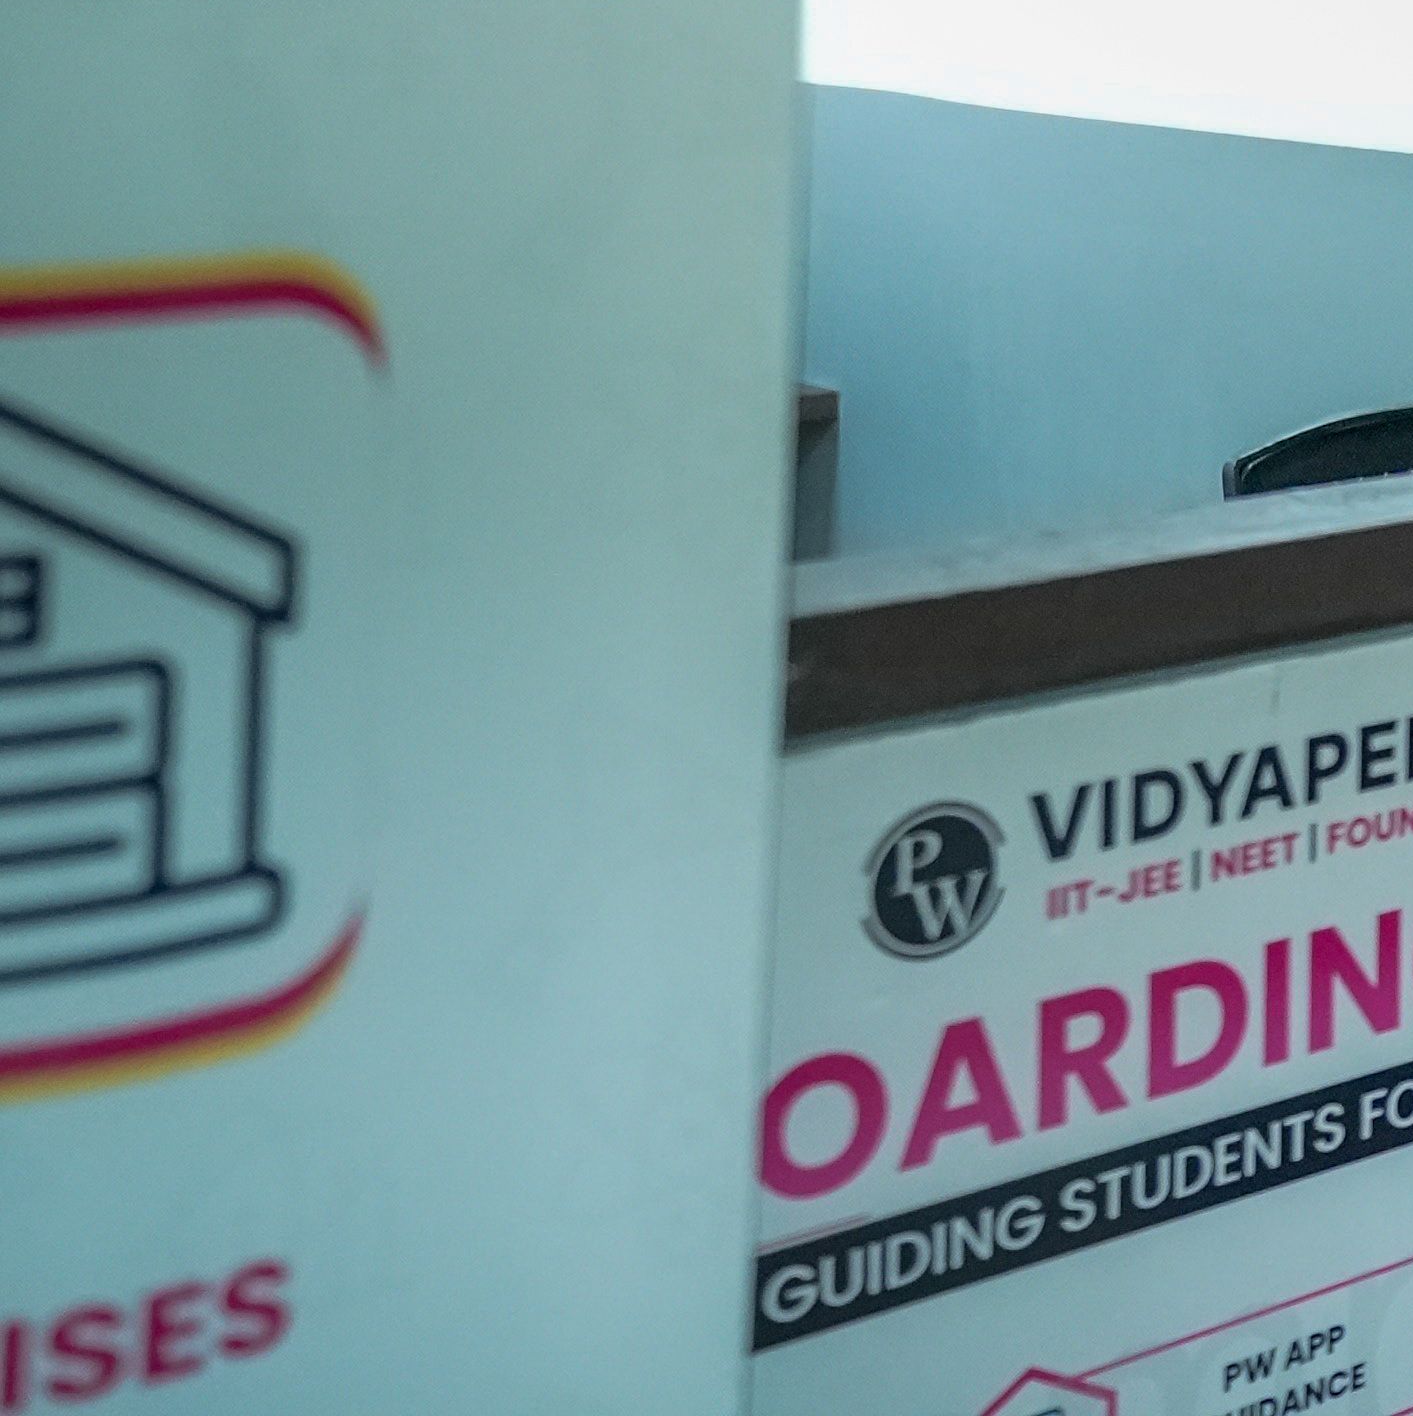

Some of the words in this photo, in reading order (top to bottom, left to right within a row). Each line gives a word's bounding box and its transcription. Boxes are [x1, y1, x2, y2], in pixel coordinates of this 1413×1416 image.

[893, 827, 990, 943] PW
[1046, 859, 1182, 920] IIT-JEE
[1210, 830, 1301, 883] NEET
[762, 1195, 1046, 1325] GUIDING
[1059, 1107, 1347, 1234] STUDENTS
[1222, 1346, 1279, 1394] PW
[1283, 1323, 1347, 1372] APP
